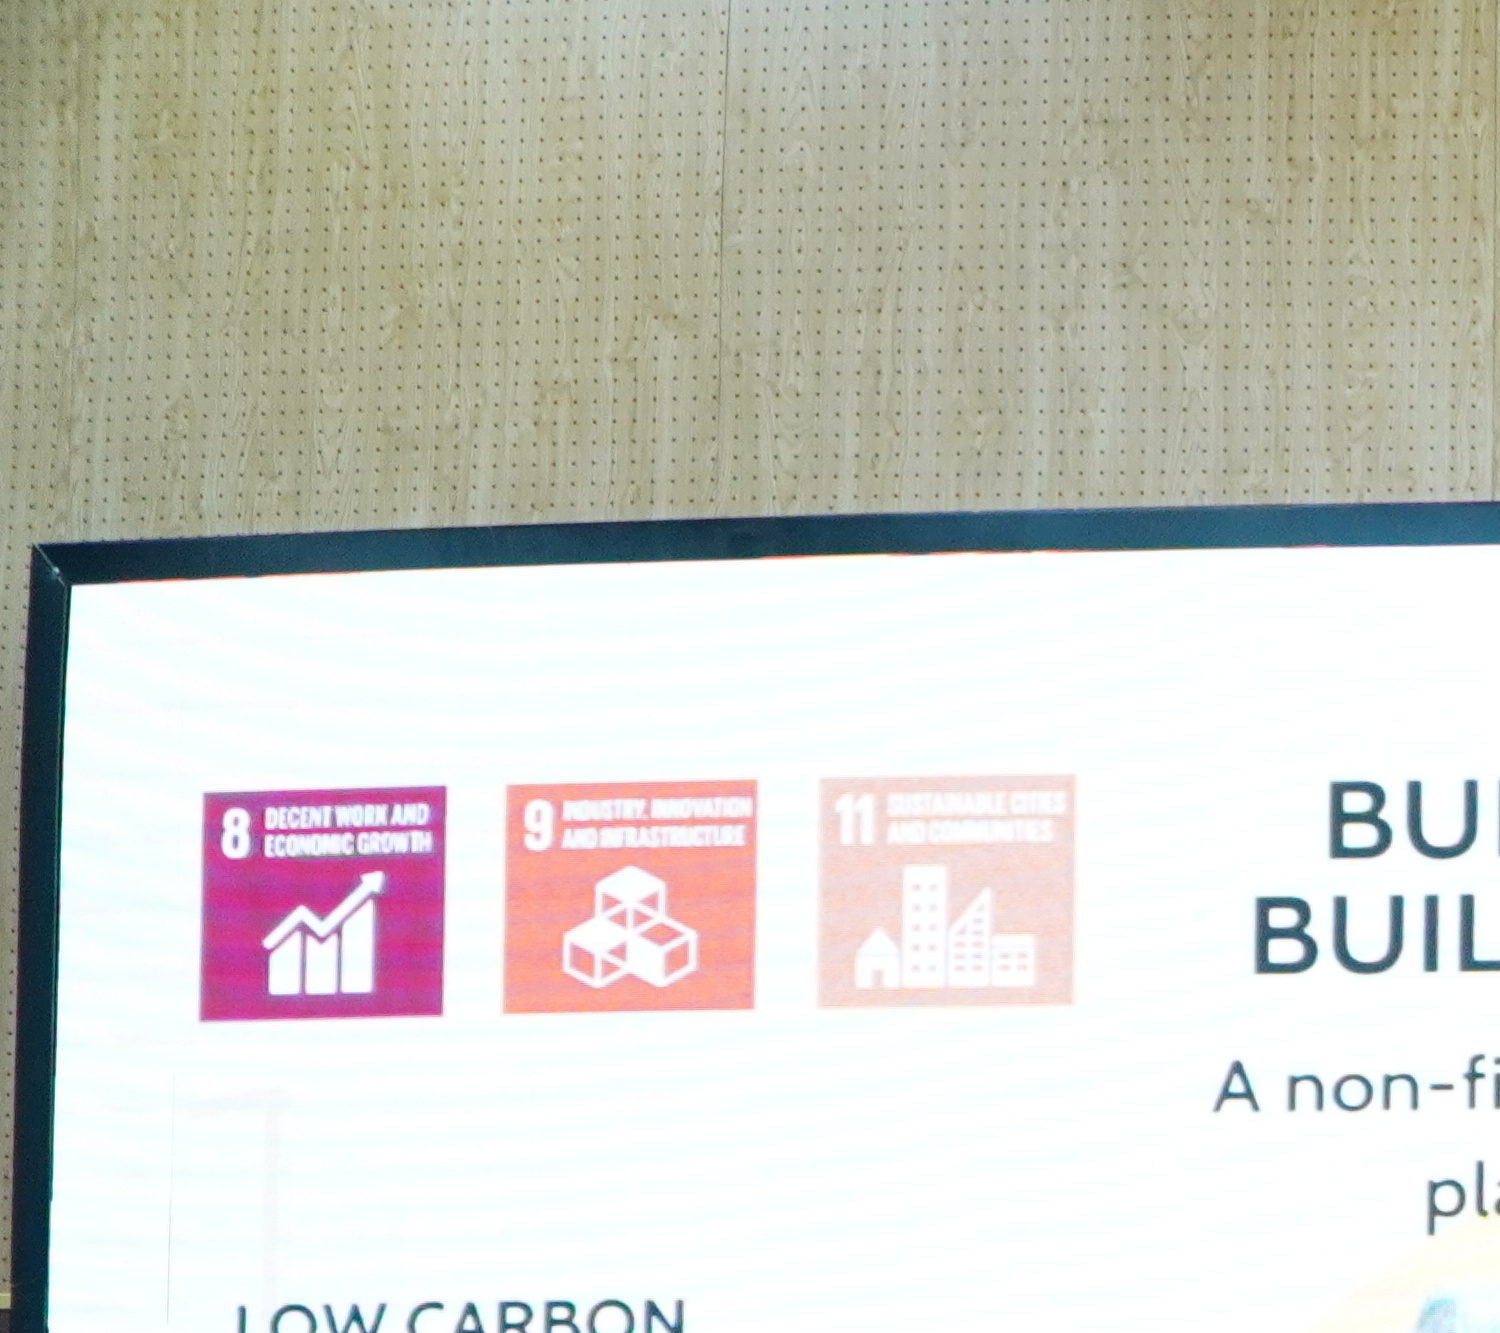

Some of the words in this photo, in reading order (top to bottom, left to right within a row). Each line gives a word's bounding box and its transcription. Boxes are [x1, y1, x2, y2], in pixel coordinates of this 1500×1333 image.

[222, 808, 250, 859] 8
[265, 805, 332, 829] DECENT
[336, 804, 386, 827] WORK
[390, 803, 429, 825] AND
[524, 799, 555, 851] 9
[836, 794, 875, 845] 11
[265, 832, 354, 857] ECONOMIC
[357, 830, 433, 855] GROWTH
[1214, 1061, 1259, 1112] A
